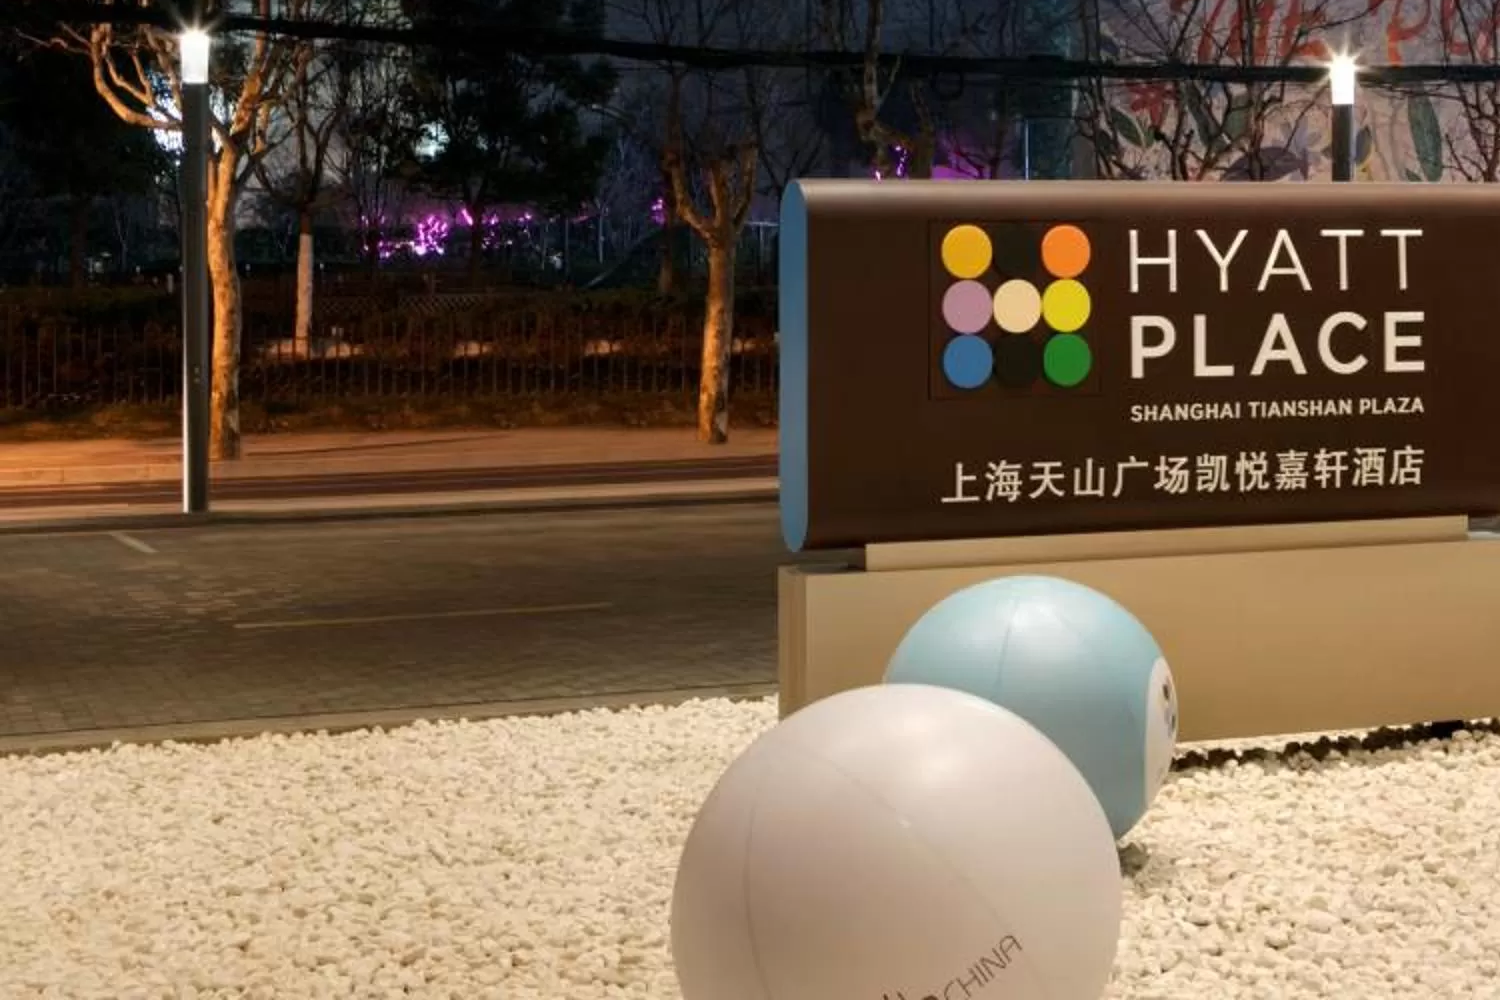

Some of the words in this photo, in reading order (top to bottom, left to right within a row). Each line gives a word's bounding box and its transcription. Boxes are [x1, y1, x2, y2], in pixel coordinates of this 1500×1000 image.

[1128, 228, 1424, 293] HYATT
[1130, 310, 1426, 379] PLACE
[1130, 401, 1242, 423] SHANGHAI
[1248, 398, 1353, 419] TIANSHAN
[1359, 396, 1425, 415] PLAZA
[940, 445, 1425, 503] 上海天山广场凯悦嘉轩酒店
